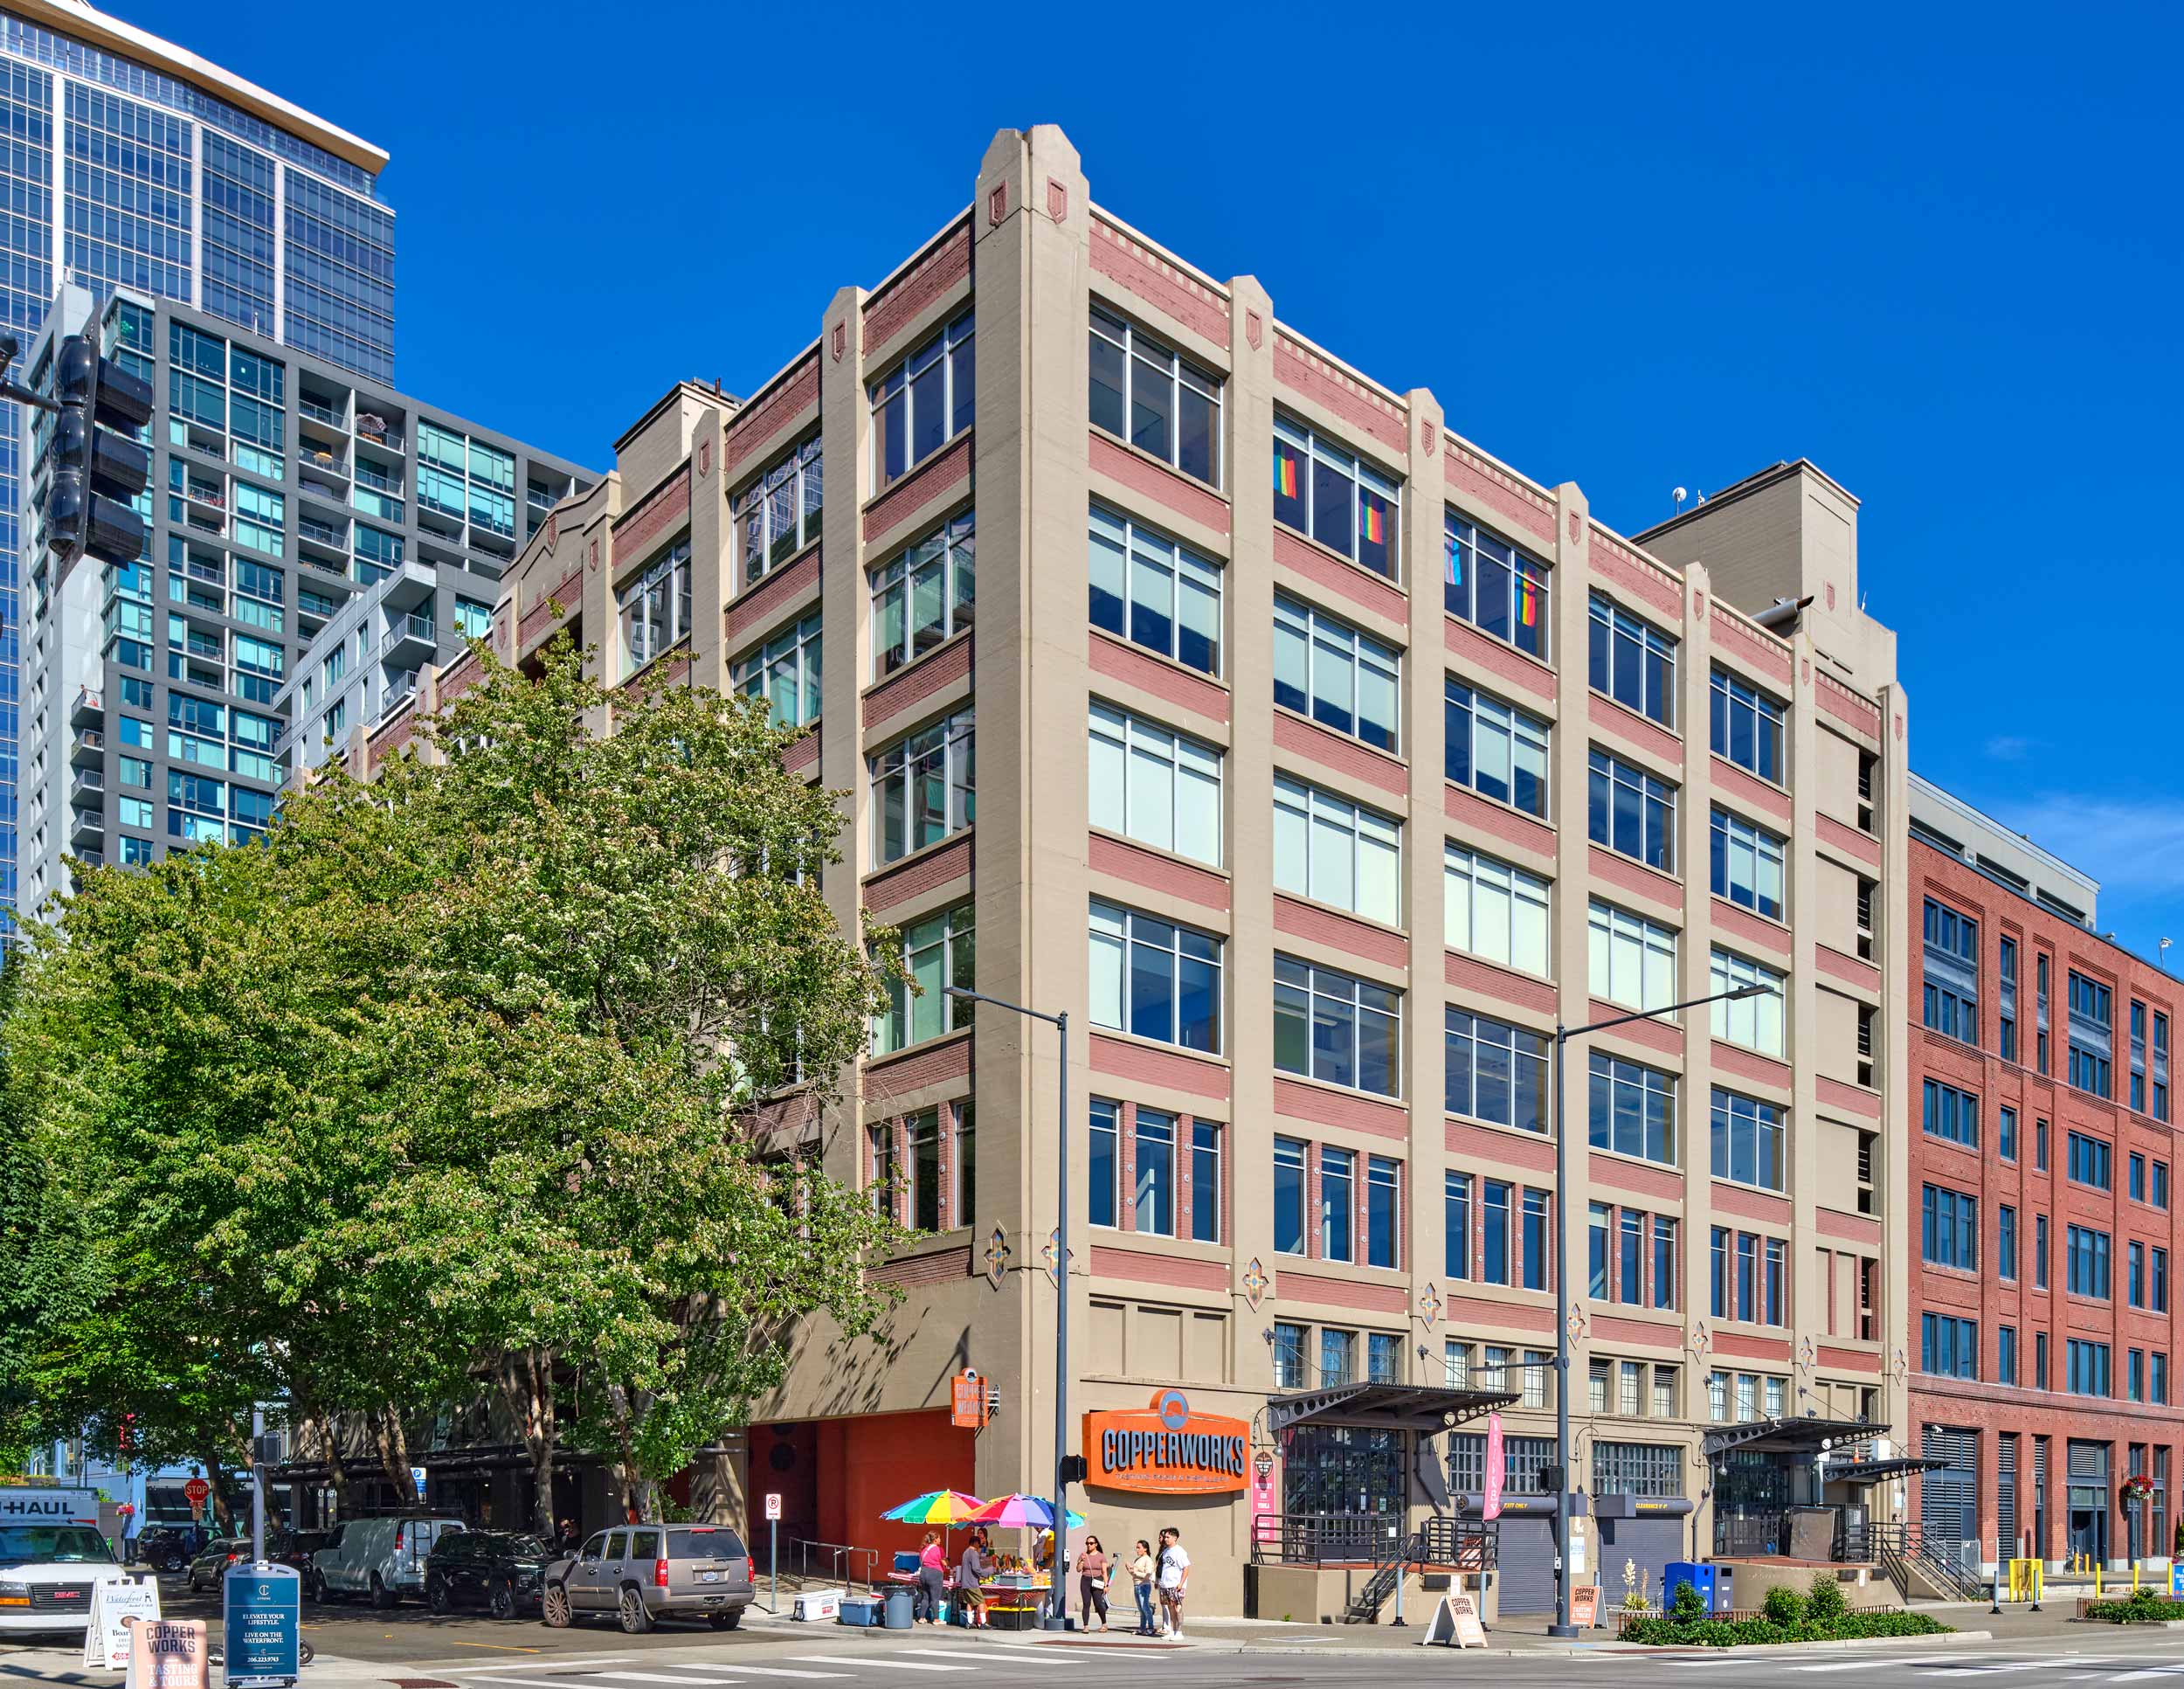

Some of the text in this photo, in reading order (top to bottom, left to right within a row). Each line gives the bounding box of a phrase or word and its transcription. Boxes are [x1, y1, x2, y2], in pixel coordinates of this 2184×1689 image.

[957, 1384, 985, 1399] COPPER
[957, 1400, 985, 1416] WORKS
[1102, 1429, 1245, 1477] COPPERWORKS
[186, 1485, 208, 1494] STOP
[0, 1501, 74, 1515] -HAUL
[1451, 1597, 1471, 1608] COPPER
[1454, 1606, 1474, 1616] WORKS
[146, 1625, 196, 1640] COPPER
[147, 1639, 196, 1654] WORKS
[147, 1664, 198, 1675] TASTING
[148, 1675, 199, 1687] & TOURS
